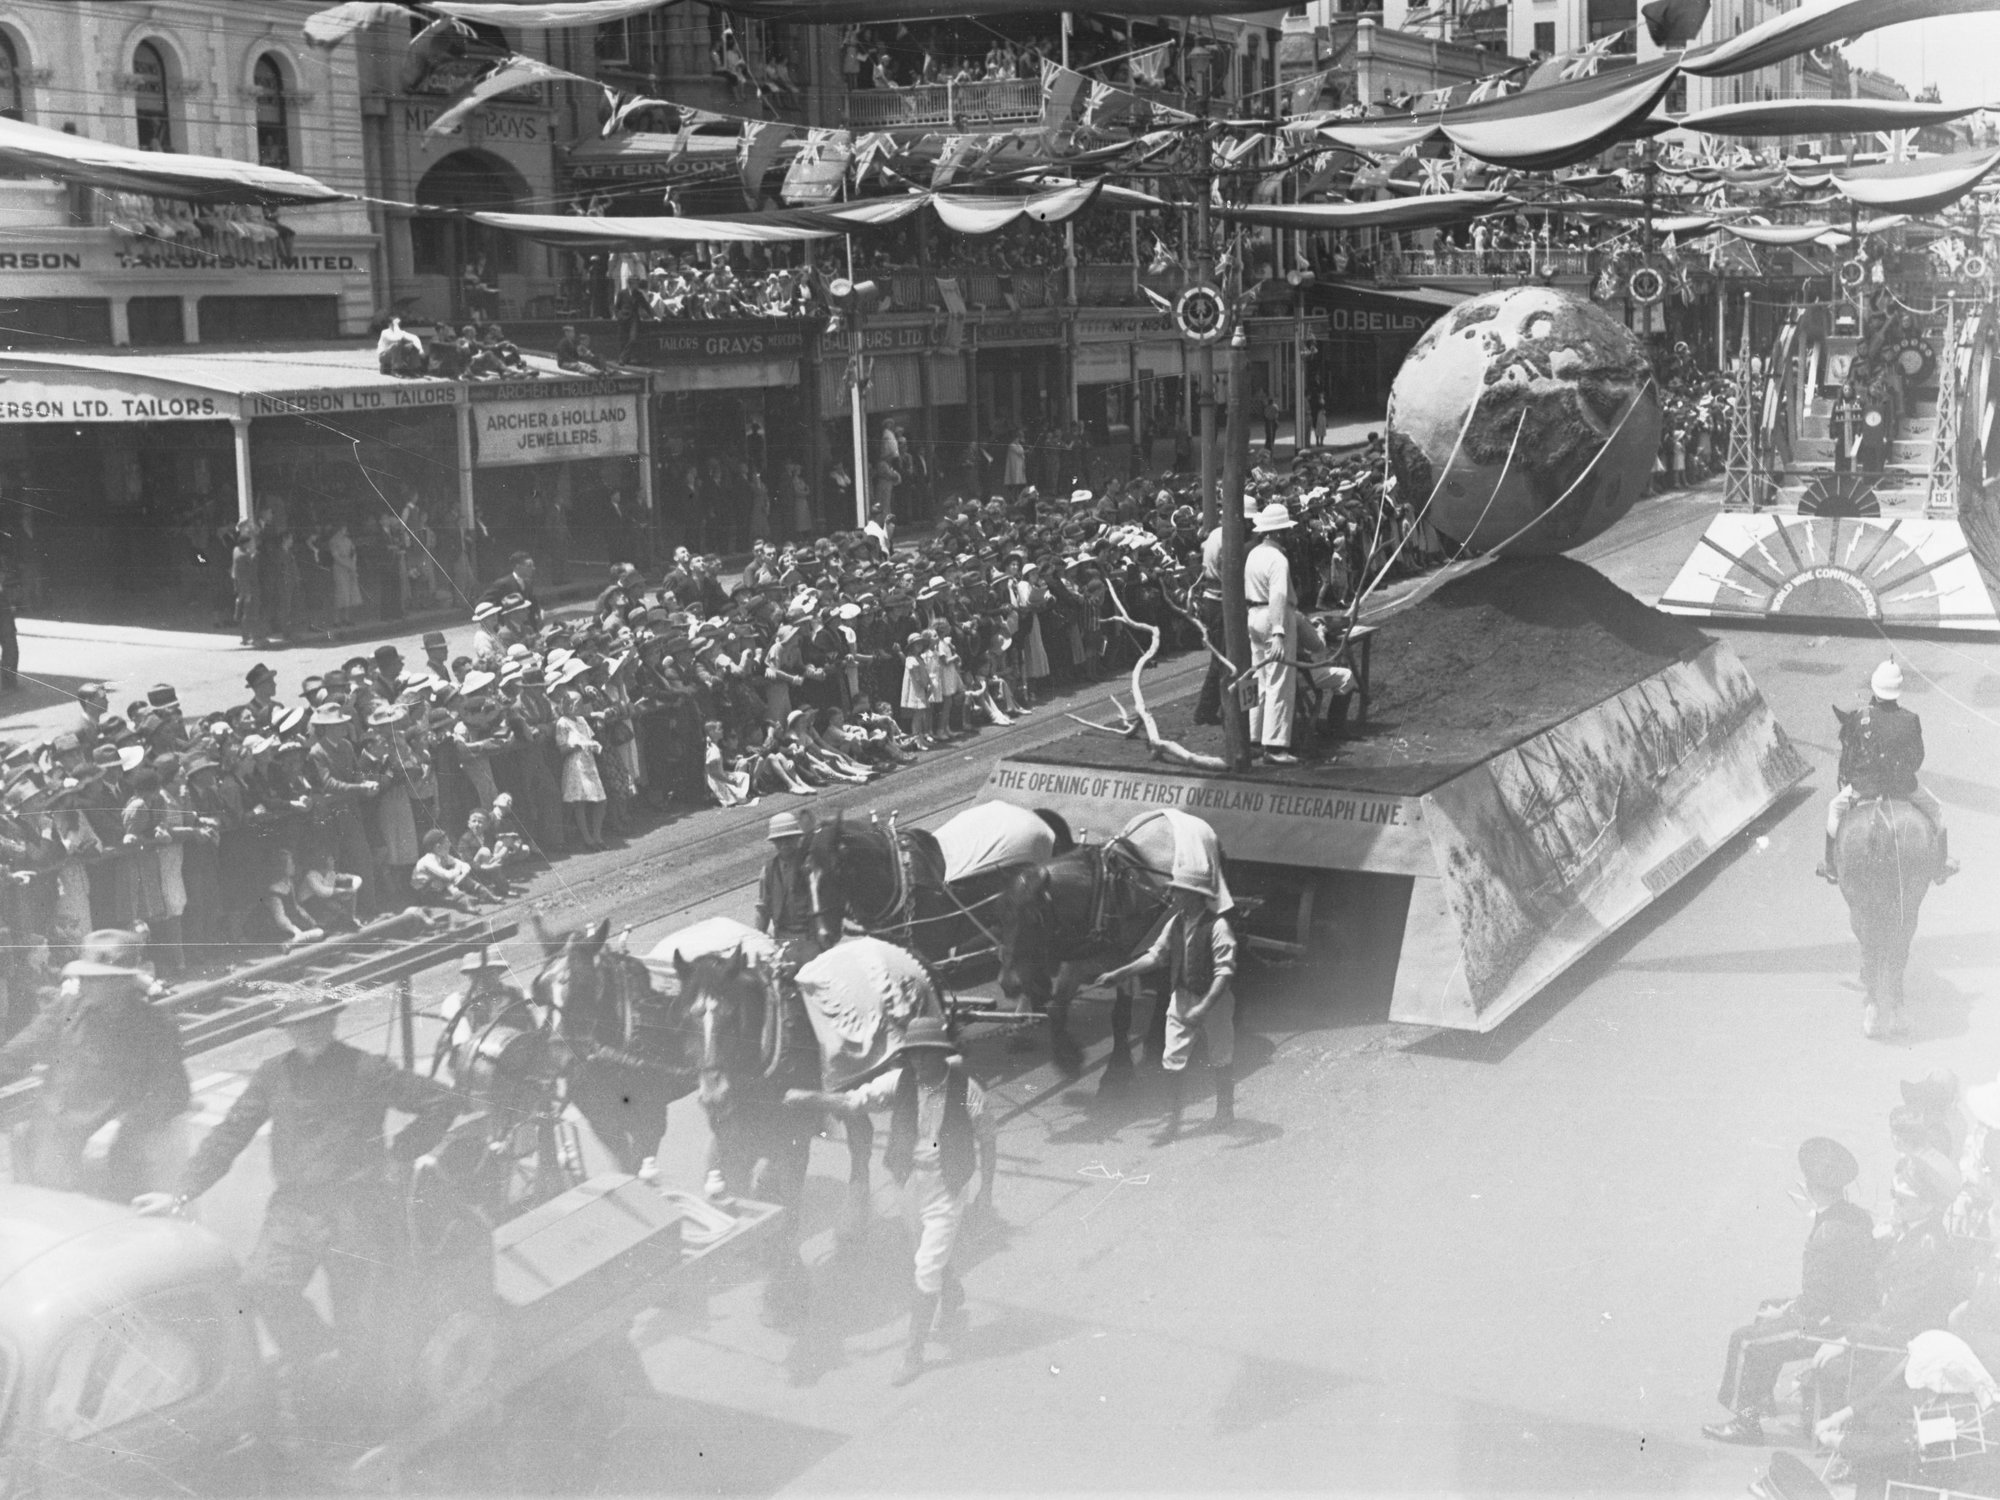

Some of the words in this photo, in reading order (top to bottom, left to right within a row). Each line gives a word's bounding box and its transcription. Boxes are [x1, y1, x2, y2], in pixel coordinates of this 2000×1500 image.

[572, 160, 727, 178] AFTERNOON
[658, 337, 699, 351] TAILORS
[706, 335, 763, 354] GRAYS
[499, 383, 549, 399] ARCHER
[562, 380, 618, 397] HOLLAND
[73, 400, 112, 417] LTD.
[122, 398, 219, 416] TAILORS.
[254, 394, 344, 415] INGERSON
[352, 392, 385, 408] LTD.
[394, 387, 456, 406] TAILORS
[487, 412, 548, 431] ARCHER
[552, 414, 559, 427] &
[562, 408, 626, 426] HOLLAND
[518, 429, 602, 449] JEWELLERS.
[999, 769, 1027, 789] THE
[1028, 772, 1089, 796] OPENING
[1091, 778, 1111, 798] OF
[1113, 780, 1142, 801] THE
[1142, 783, 1184, 805] FIRST
[1186, 786, 1264, 812] OVERLAND
[1269, 794, 1355, 821] TELEGRAPH
[1360, 802, 1407, 826] LINE.
